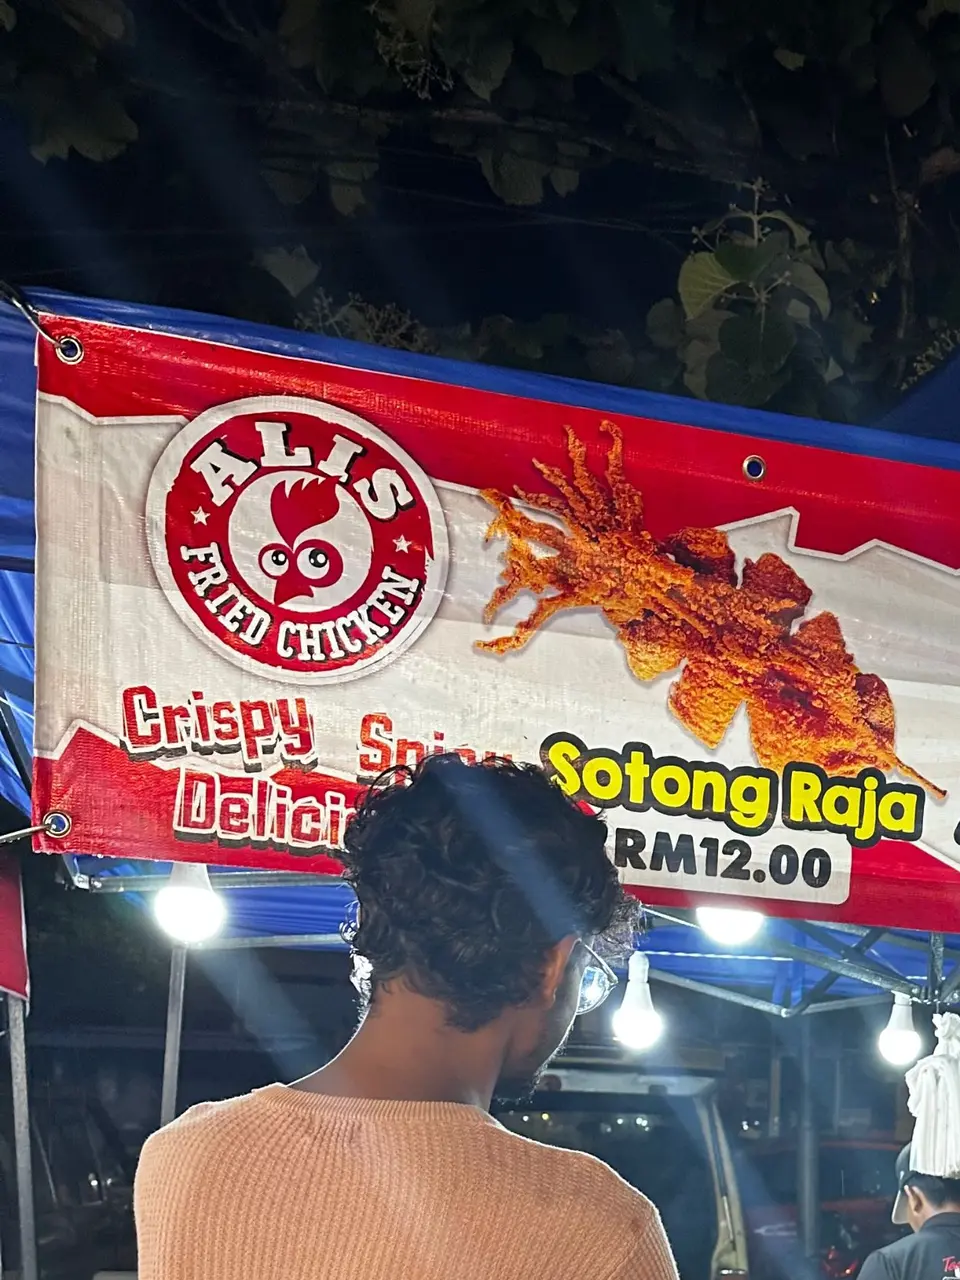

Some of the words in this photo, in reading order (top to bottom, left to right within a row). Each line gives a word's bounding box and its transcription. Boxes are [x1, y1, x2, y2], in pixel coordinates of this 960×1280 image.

[188, 421, 415, 521] ALIS
[179, 540, 272, 647] FRIED
[275, 564, 420, 661] CHICKEN
[121, 684, 316, 761] Crispy
[546, 739, 771, 829] Sotong
[789, 769, 918, 840] Raja
[613, 827, 833, 889] RM12.00
